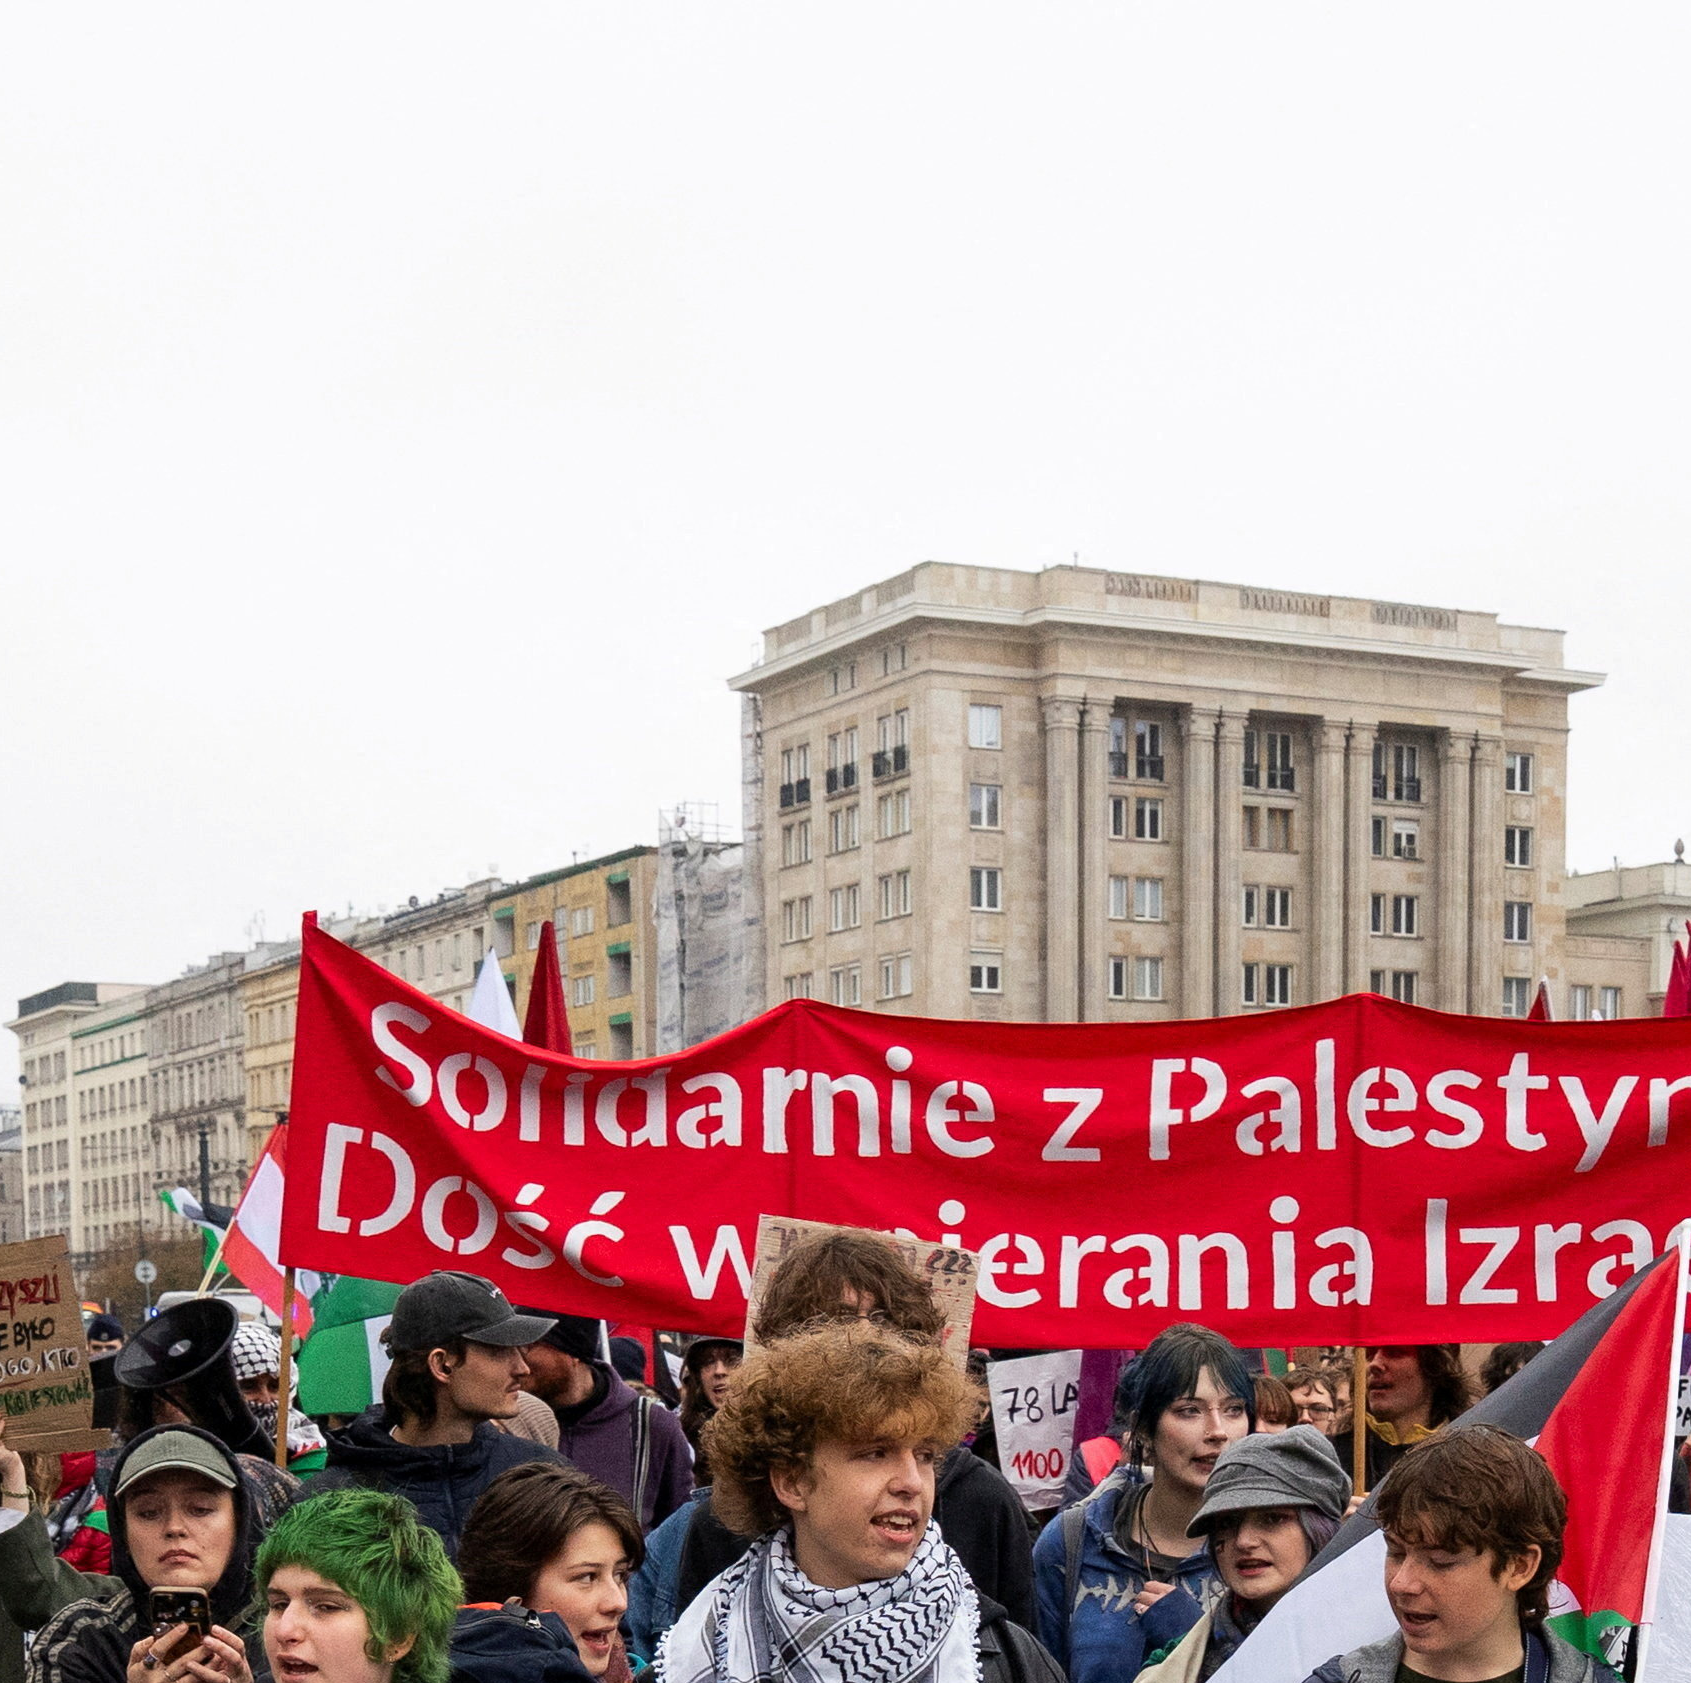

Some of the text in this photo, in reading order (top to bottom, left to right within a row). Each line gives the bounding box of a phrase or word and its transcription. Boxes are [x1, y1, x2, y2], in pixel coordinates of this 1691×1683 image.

[370, 1000, 995, 1159] Solidarnie
[1043, 1087, 1103, 1162] z
[316, 1122, 625, 1288] Dość
[1000, 1381, 1080, 1424] 78 LA
[1011, 1448, 1064, 1480] 1100
